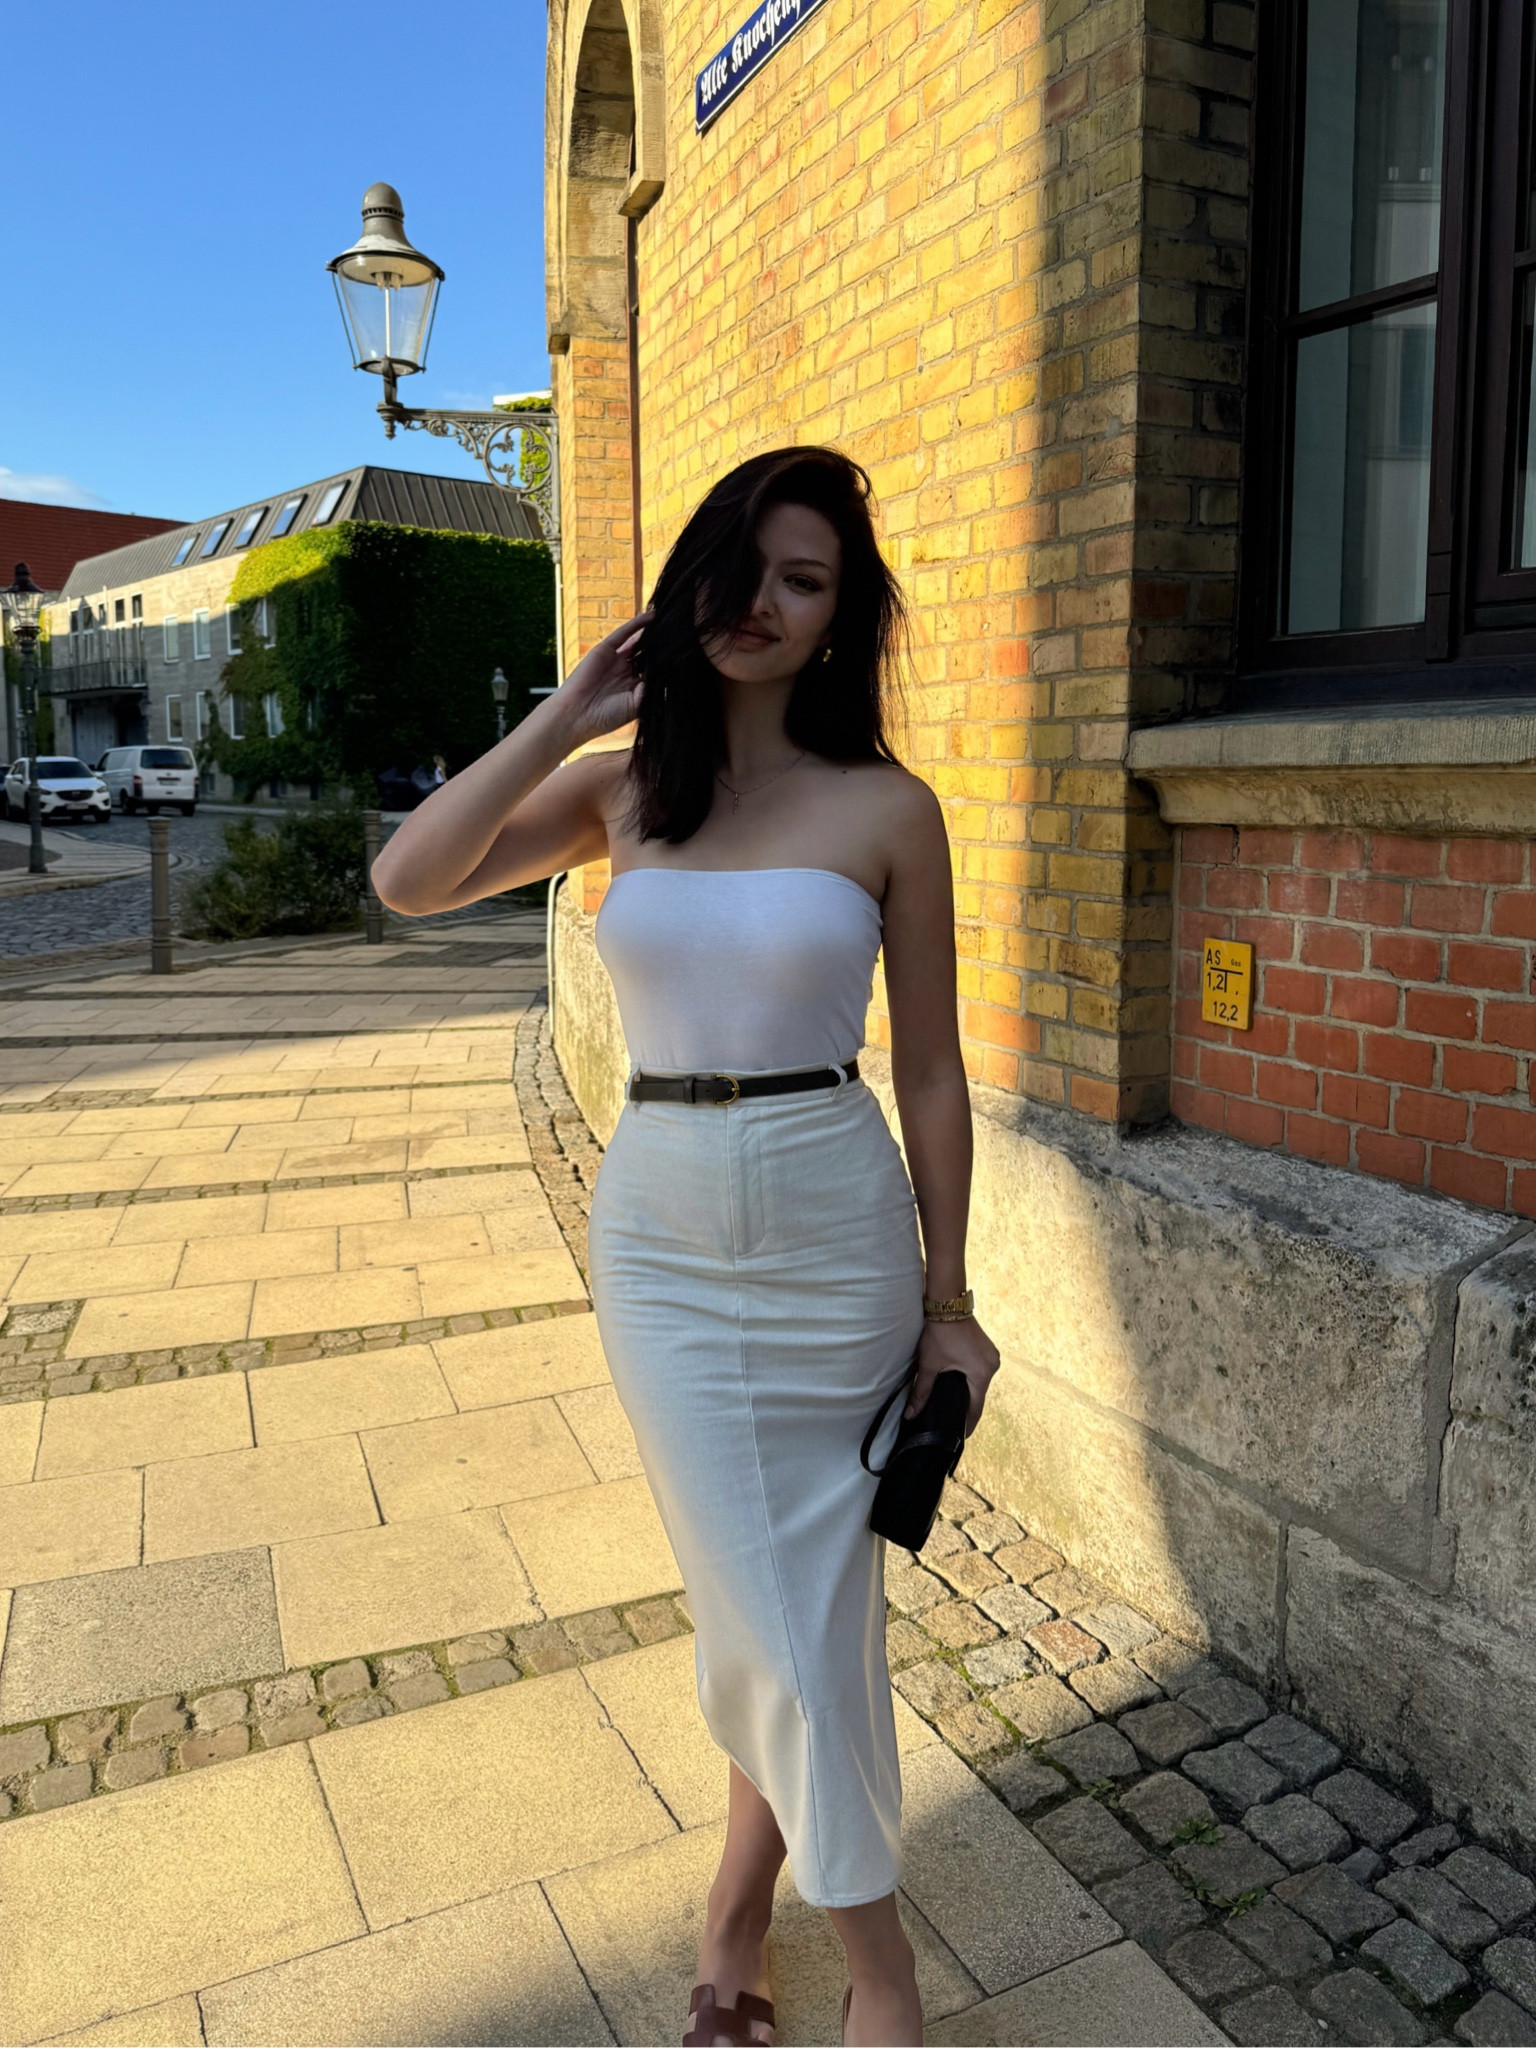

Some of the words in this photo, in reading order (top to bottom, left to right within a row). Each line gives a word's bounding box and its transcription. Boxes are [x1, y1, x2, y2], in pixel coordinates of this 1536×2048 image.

[700, 56, 728, 106] Alte
[1206, 948, 1221, 966] AS
[1213, 1001, 1238, 1022] 12,2
